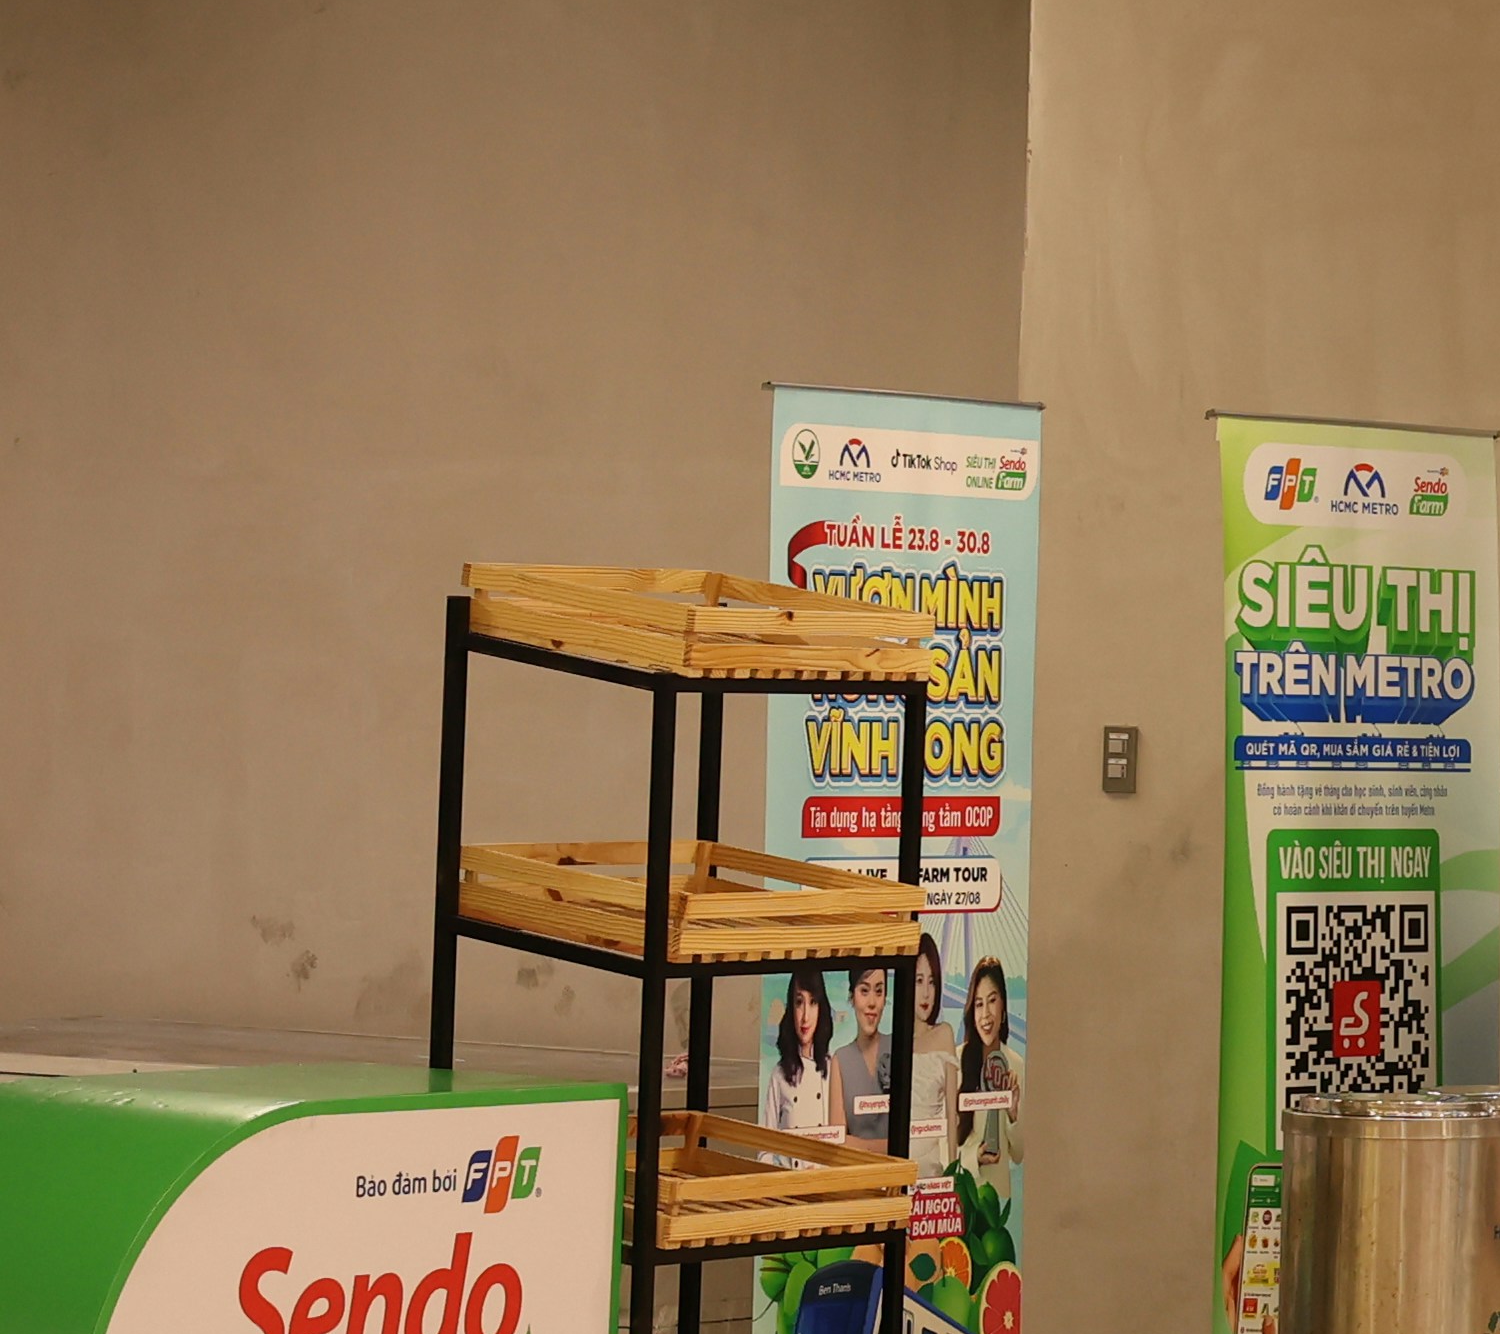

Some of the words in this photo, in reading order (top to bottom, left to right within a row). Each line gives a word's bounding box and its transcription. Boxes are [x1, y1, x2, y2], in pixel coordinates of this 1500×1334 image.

[902, 452, 932, 471] TikTok
[934, 456, 958, 475] Shop
[828, 469, 851, 482] HCMC
[853, 471, 881, 483] METRO
[1414, 476, 1447, 495] Sendo
[1330, 500, 1359, 513] HCMC
[1362, 502, 1399, 515] METRO
[1412, 496, 1446, 515] Farm
[825, 515, 874, 549] TUẦN
[881, 516, 902, 550] LỄ
[909, 528, 939, 552] 23.8
[956, 530, 990, 554] 30.8
[1238, 545, 1370, 635] SIÊU
[1385, 569, 1472, 651] THỊ
[927, 629, 1000, 702] SẢN
[1236, 641, 1337, 696] TRÊN
[1345, 655, 1472, 700] METRO
[805, 708, 899, 776] VĨNH
[923, 720, 1002, 776] ONG
[1246, 740, 1275, 756] QUÉT
[1279, 741, 1297, 755] MÃ
[1301, 744, 1320, 758] QR,
[1323, 744, 1343, 756] MUA
[1346, 739, 1368, 756] SẮM
[1372, 741, 1393, 757] GIÁ
[1396, 742, 1410, 757] RẺ
[1420, 743, 1440, 760] TIỆN
[1442, 744, 1460, 760] LỢI
[1278, 840, 1315, 879] VÀO
[1319, 840, 1352, 879] SIÊU
[1356, 846, 1385, 883] THỊ
[1391, 846, 1432, 878] NGAY
[918, 867, 950, 883] FARM
[955, 867, 987, 882] TOUR
[926, 889, 953, 905] NGÀY
[955, 891, 981, 905] 27/08
[356, 1175, 387, 1198] Bảo
[392, 1171, 427, 1195] đảm
[432, 1169, 457, 1193] bởi
[911, 1215, 936, 1237] BỐN
[937, 1214, 962, 1234] MÙA
